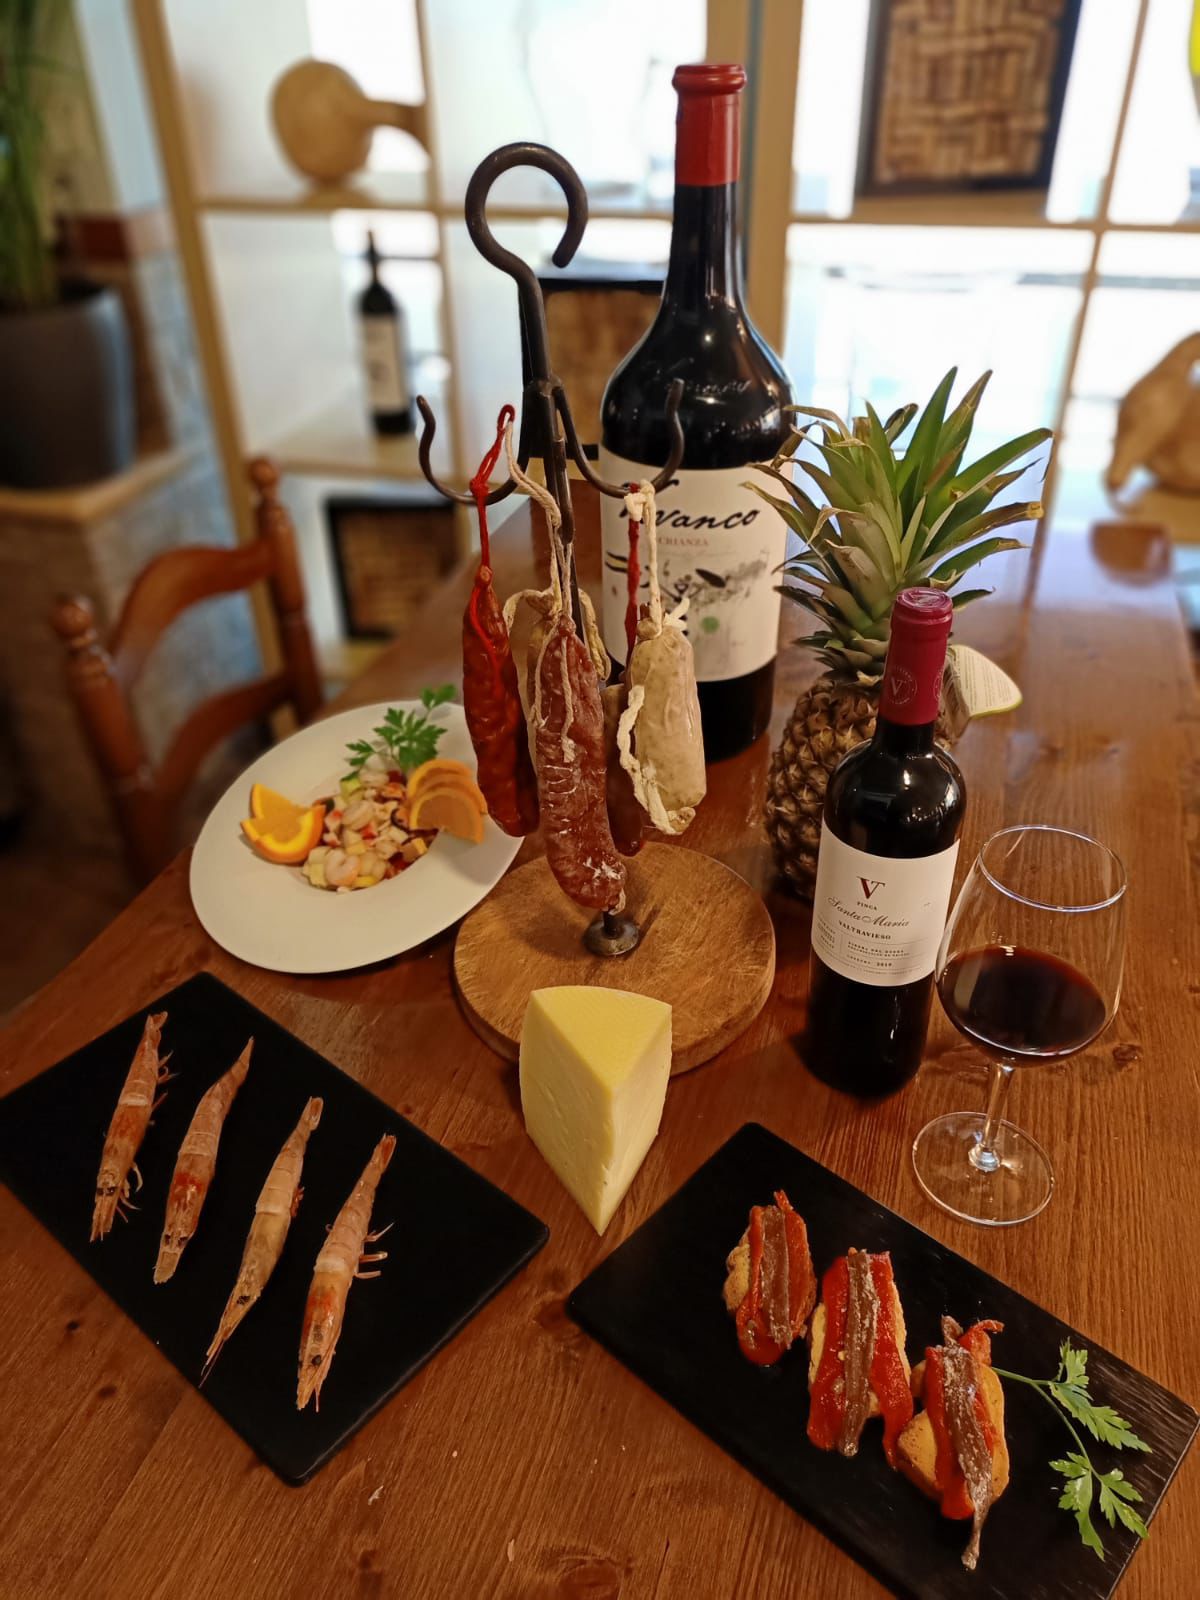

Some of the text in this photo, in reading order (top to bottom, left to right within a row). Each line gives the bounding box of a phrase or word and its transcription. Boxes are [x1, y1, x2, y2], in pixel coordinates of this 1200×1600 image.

[619, 479, 761, 530] vanco
[828, 897, 861, 920] Santa
[857, 901, 878, 911] FINCA
[838, 919, 892, 941] VALTRAVIESO
